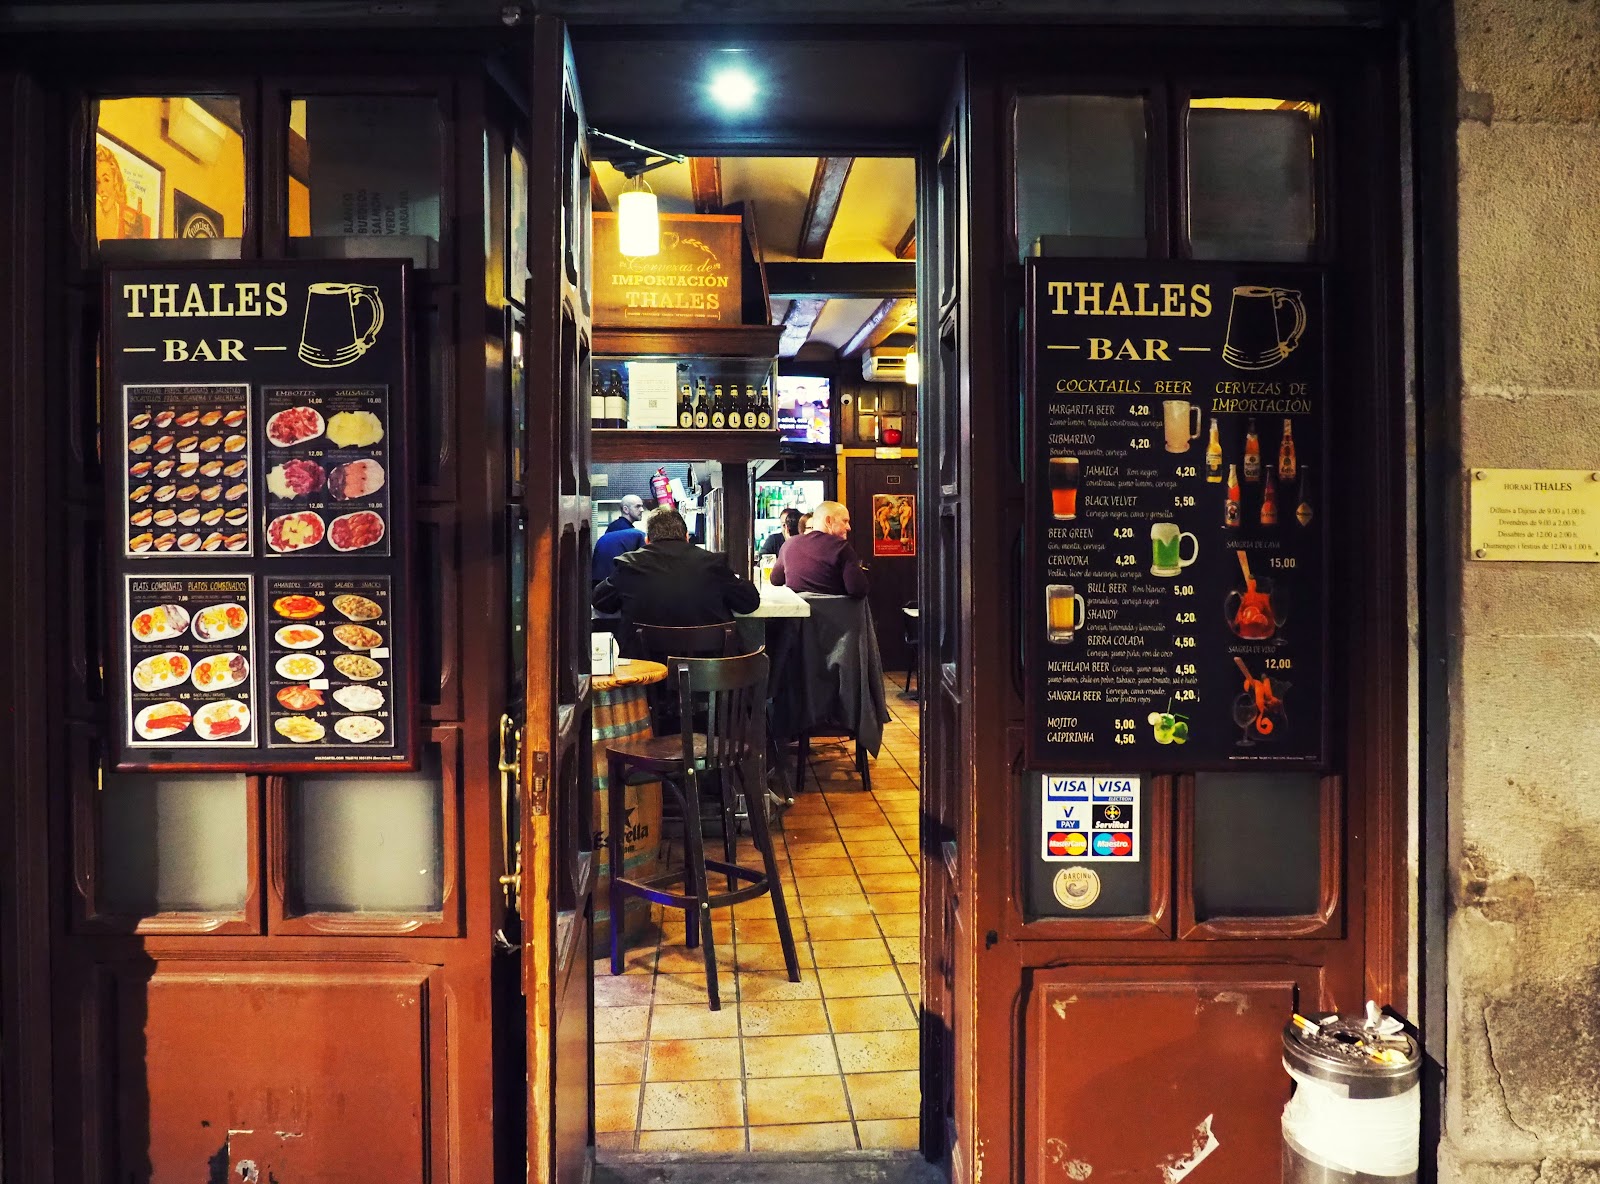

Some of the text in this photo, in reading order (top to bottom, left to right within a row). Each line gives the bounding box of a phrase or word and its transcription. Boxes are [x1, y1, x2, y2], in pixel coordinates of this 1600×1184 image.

[697, 259, 714, 272] de
[612, 273, 728, 288] IMPORTACIÓN
[124, 282, 288, 318] THALES
[626, 292, 720, 310] THALES
[1048, 282, 1212, 318] THALES
[162, 338, 248, 362] BAR
[1087, 338, 1172, 361] BAR
[1056, 379, 1192, 393] COCKTAILS BEER
[1216, 382, 1308, 396] CERVEZAS DE
[1048, 404, 1094, 414] MARGARITA
[1096, 405, 1114, 415] BEER
[1212, 397, 1312, 412] IMPORTACIÓN
[1048, 434, 1096, 444] SUBMARINO
[1084, 466, 1119, 477] JAMAICA
[1534, 482, 1572, 491] THALES
[1085, 496, 1109, 506] BLACK
[1111, 496, 1138, 506] VELVET
[1048, 528, 1067, 538] BEER
[1069, 528, 1094, 539] GREEN
[1048, 555, 1089, 565] CERVODKA
[133, 582, 246, 591] PLATS COMBINATS PLATOS COMBINADOS
[1088, 583, 1106, 593] BULL
[1108, 583, 1127, 593] BEER
[1087, 609, 1118, 620] SHANDY
[1088, 635, 1111, 646] BIRRA
[1114, 636, 1144, 646] COLADA
[1048, 661, 1090, 672] MICHELADA
[1092, 662, 1110, 672] BEER
[1265, 659, 1291, 670] 12,00
[1047, 690, 1081, 702] SANGRIA
[1083, 690, 1101, 701] BEER
[1048, 717, 1078, 729] MOJITO
[1047, 732, 1094, 743] CAIPIRINHA
[1053, 781, 1086, 792] VISA
[1098, 781, 1131, 792] VISA
[1062, 806, 1074, 818] V
